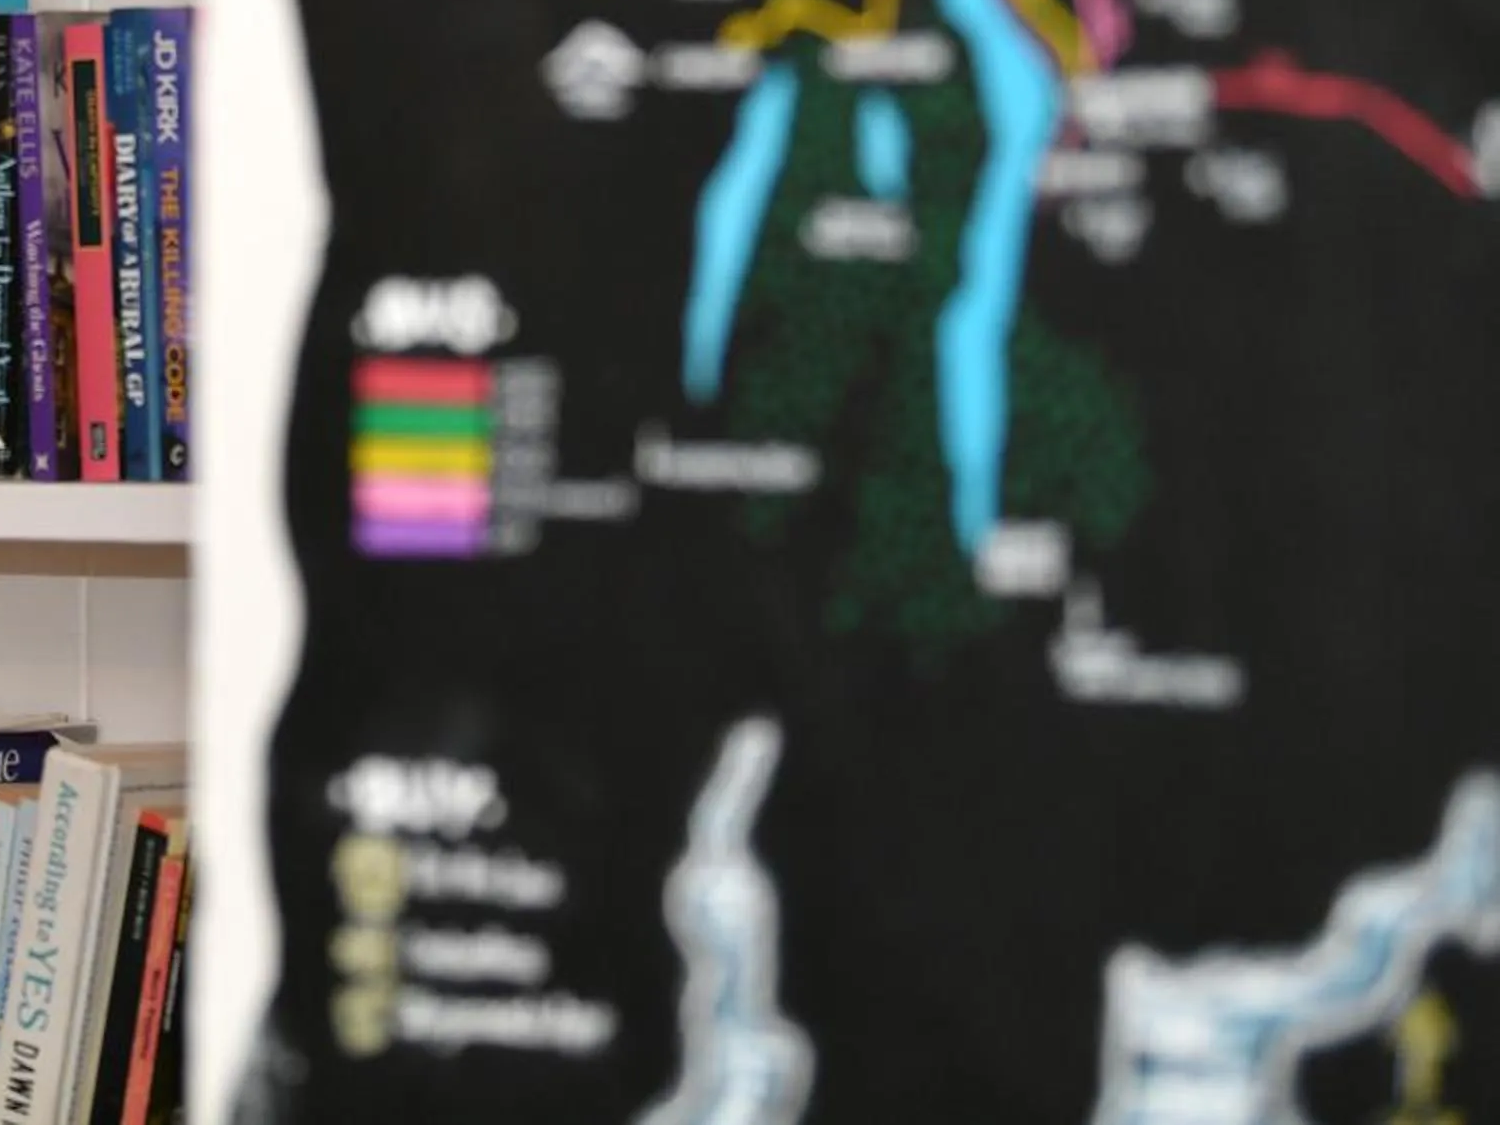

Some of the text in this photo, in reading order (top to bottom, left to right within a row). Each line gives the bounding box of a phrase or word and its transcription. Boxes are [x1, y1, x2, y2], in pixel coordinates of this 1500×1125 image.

[15, 36, 41, 179] KATE ELLIS
[153, 29, 180, 145] JD KIRK
[113, 132, 147, 407] DIARY RURAL GP
[159, 167, 190, 424] THE KILLING CODE
[33, 779, 81, 913] According
[17, 946, 61, 1034] YES
[36, 918, 57, 943] to
[3, 1039, 42, 1116] DAWN
